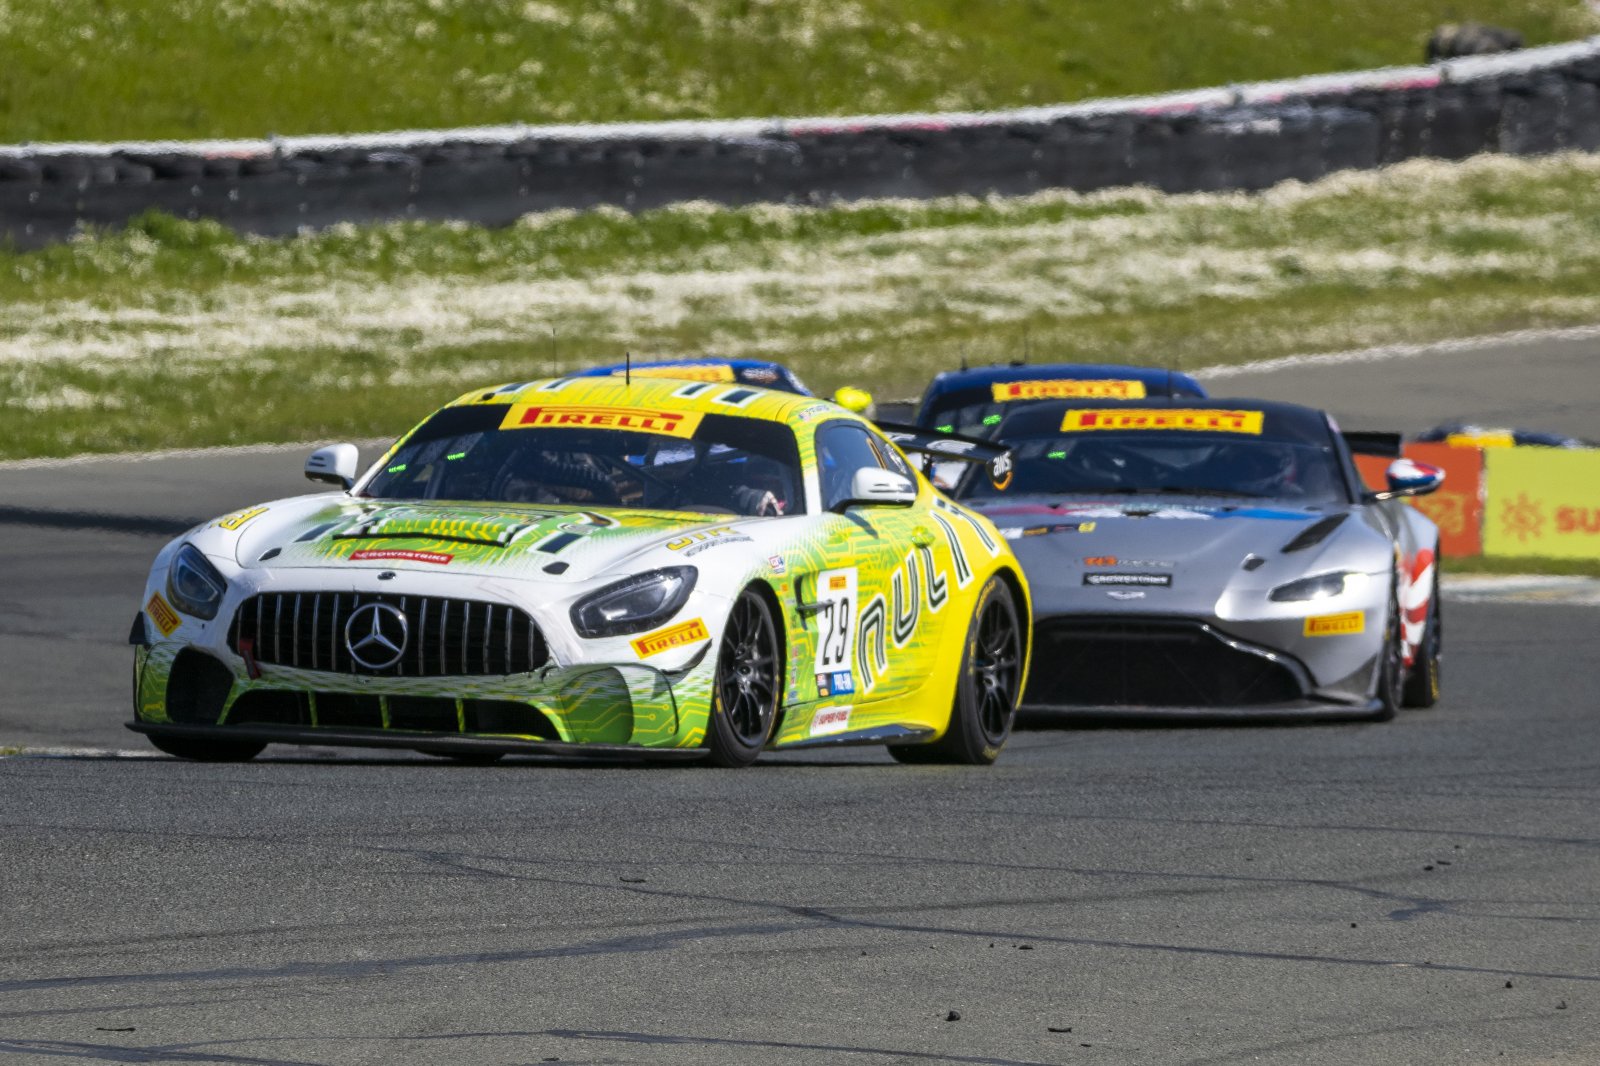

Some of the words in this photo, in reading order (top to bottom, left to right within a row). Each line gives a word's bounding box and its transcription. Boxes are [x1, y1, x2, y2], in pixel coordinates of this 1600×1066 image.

[520, 407, 684, 431] PIRELLI
[1080, 411, 1246, 428] PIRELLI
[147, 592, 179, 633] PIRELLI
[1309, 614, 1360, 633] PIRELLI
[636, 621, 703, 655] PIRELLI
[821, 597, 849, 666] 29
